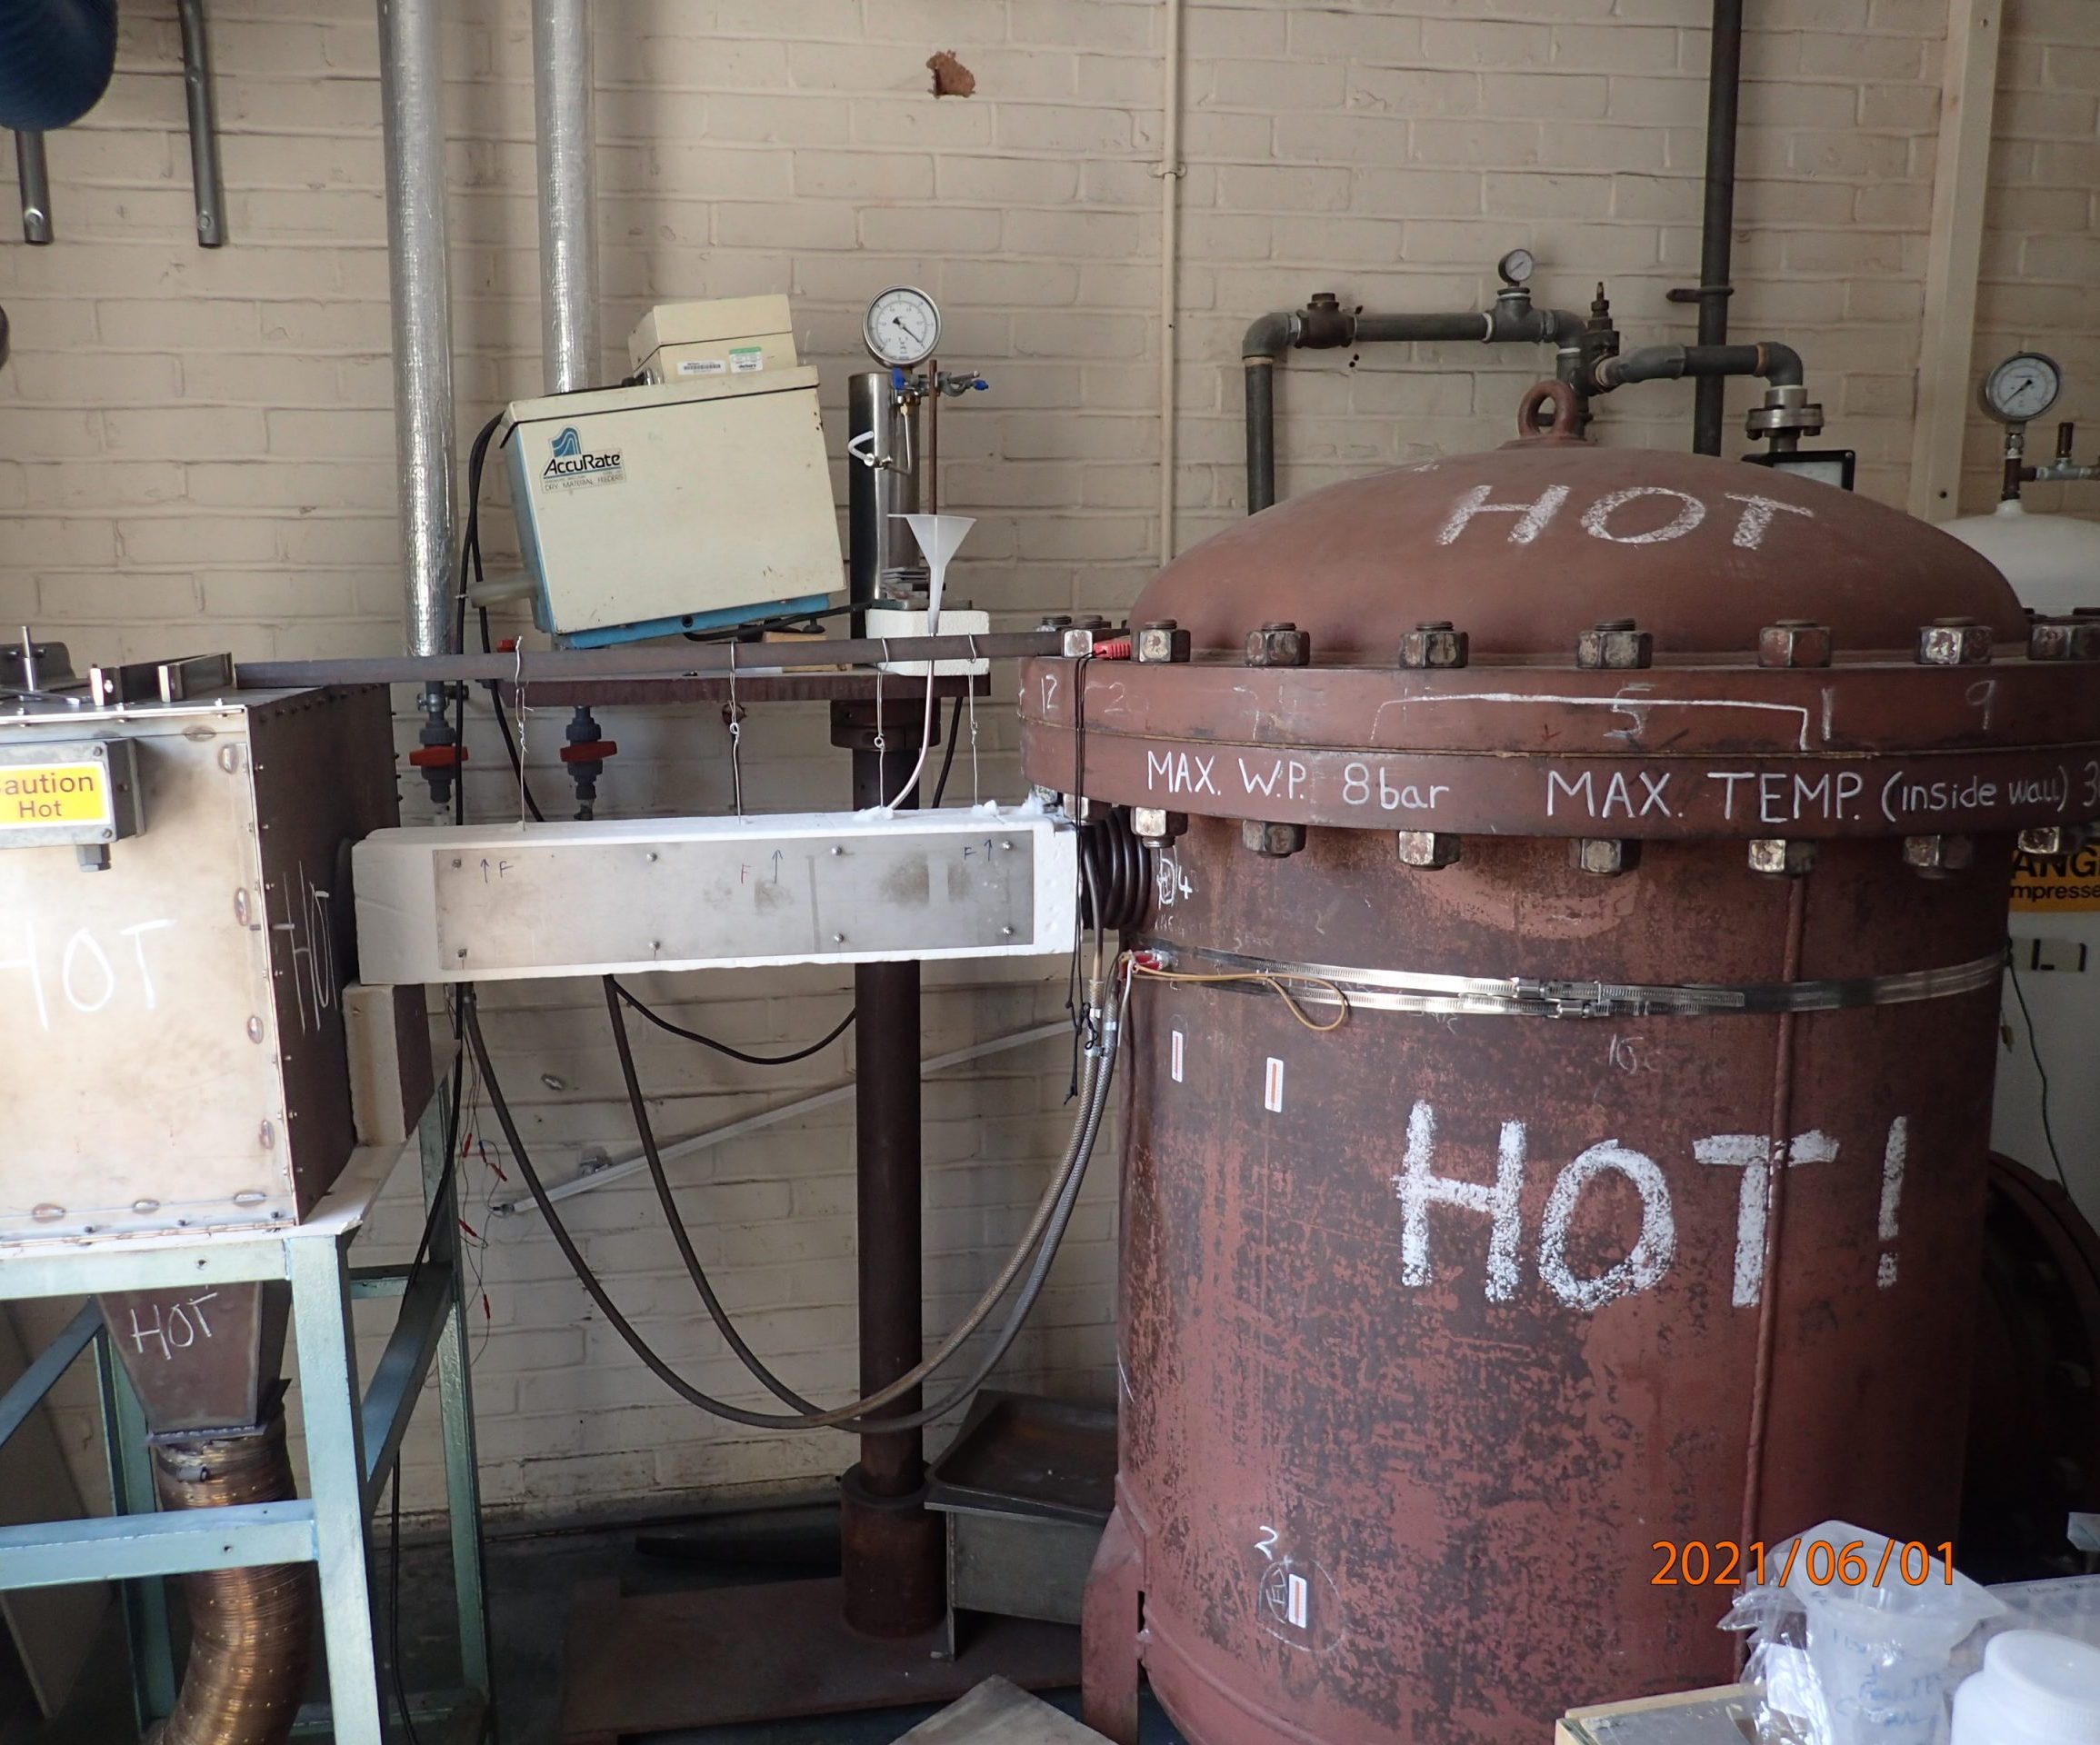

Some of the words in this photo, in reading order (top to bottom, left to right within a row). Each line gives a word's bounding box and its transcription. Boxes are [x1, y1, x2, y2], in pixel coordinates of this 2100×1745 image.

[544, 454, 620, 475] AccuRate
[1436, 484, 1814, 550] HOT
[0, 772, 95, 796] aution
[1147, 750, 1222, 796] MAX.
[1238, 757, 1307, 800] W.P.
[1342, 763, 1370, 806] 8
[1379, 766, 1450, 811] bar
[1546, 770, 1685, 819] MAX.
[1707, 771, 1864, 823] TEMP.
[1881, 771, 1995, 823] (inside
[2082, 761, 2100, 808] 3
[19, 800, 63, 818] Hot
[964, 846, 977, 860] F
[2010, 845, 2100, 878] ANG
[499, 860, 514, 879] F
[741, 863, 752, 884] F
[2010, 883, 2100, 902] mpresse
[130, 1291, 218, 1361] HOT
